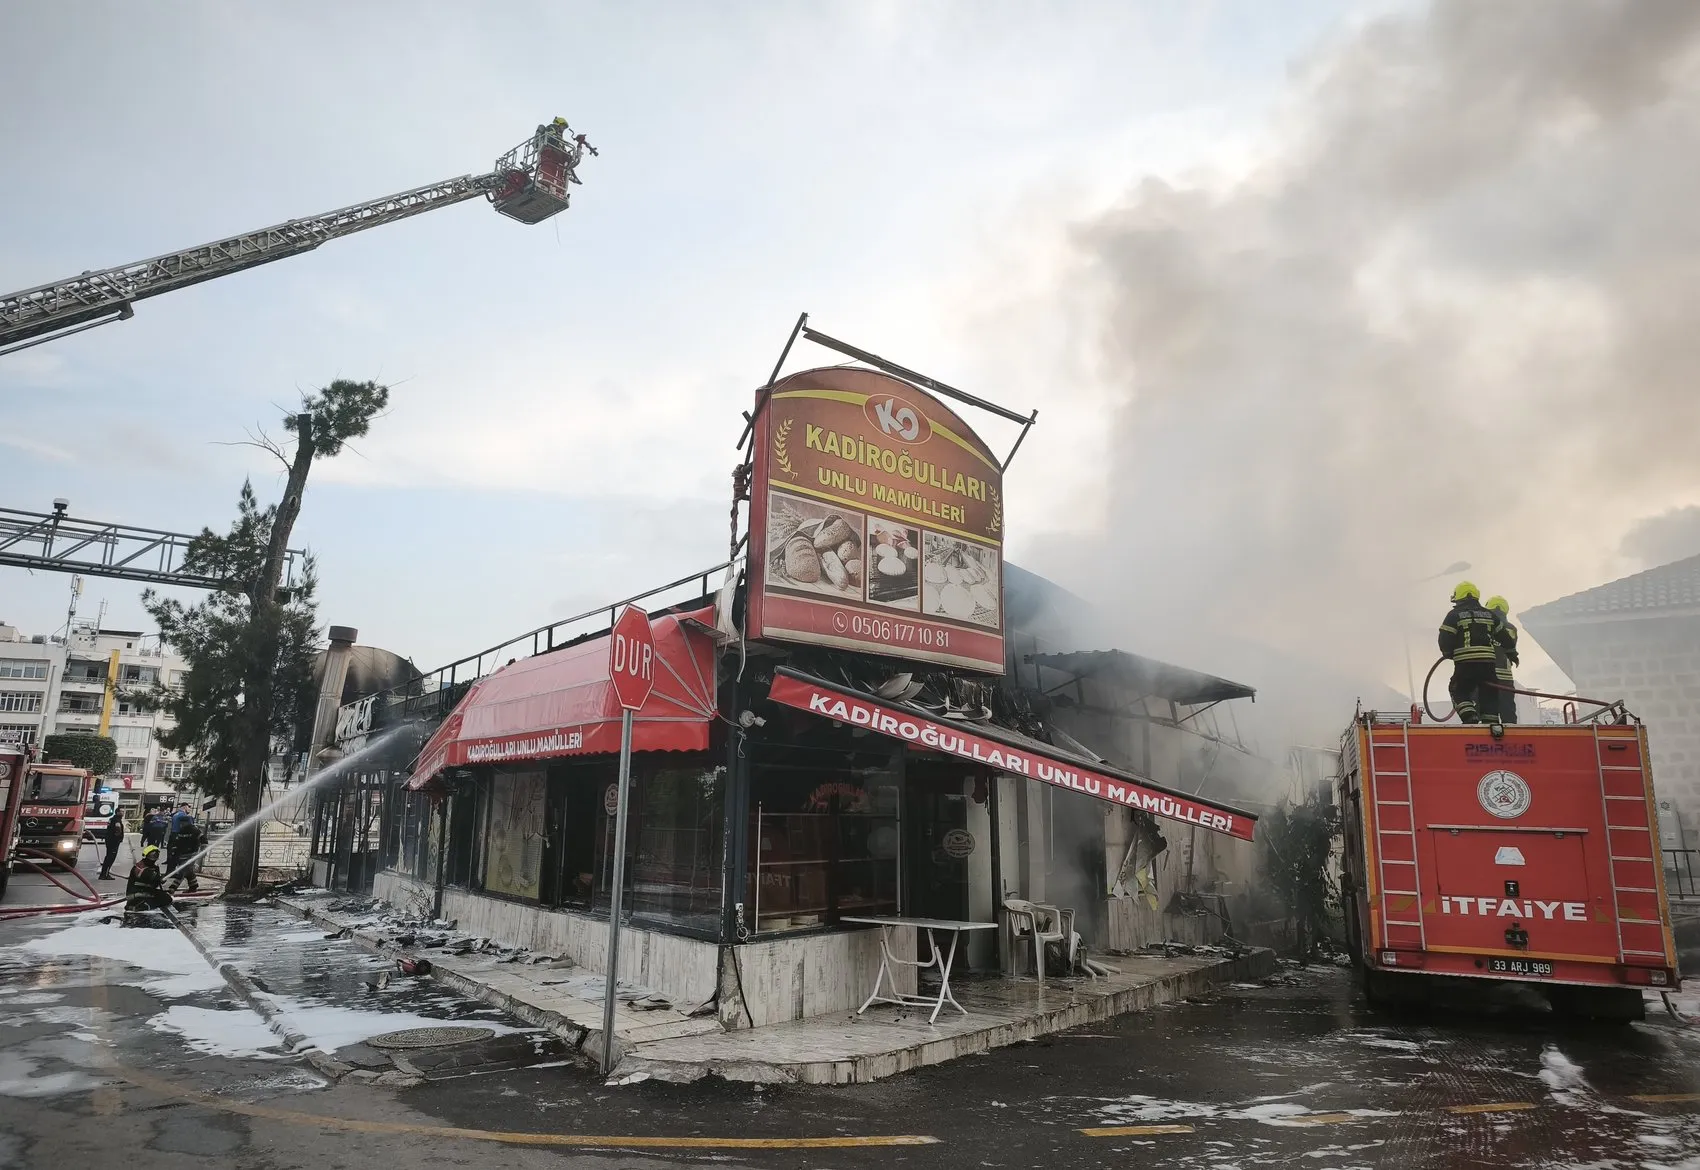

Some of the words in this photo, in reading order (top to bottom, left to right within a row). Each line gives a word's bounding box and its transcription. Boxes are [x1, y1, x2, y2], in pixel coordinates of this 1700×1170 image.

[805, 423, 987, 502] KADİROĞULLARI
[818, 467, 867, 495] UNLU
[872, 483, 965, 524] MAMÜLLERİ
[852, 615, 890, 639] 0506
[894, 624, 915, 642] 177
[918, 628, 932, 645] 10
[936, 630, 949, 647] 81
[614, 633, 651, 681] DUR
[467, 740, 516, 759] KADİROĞULLARI
[517, 739, 536, 755] UNLU
[537, 725, 582, 752] MAMÜLLERİ
[808, 692, 1031, 773] KADİROĞULLARI
[1037, 762, 1102, 795] UNLU
[1108, 782, 1234, 833] MAMÜLLERİ
[1441, 896, 1587, 921] İTFAİYE
[1494, 960, 1506, 971] 33
[1511, 961, 1529, 972] ARJ
